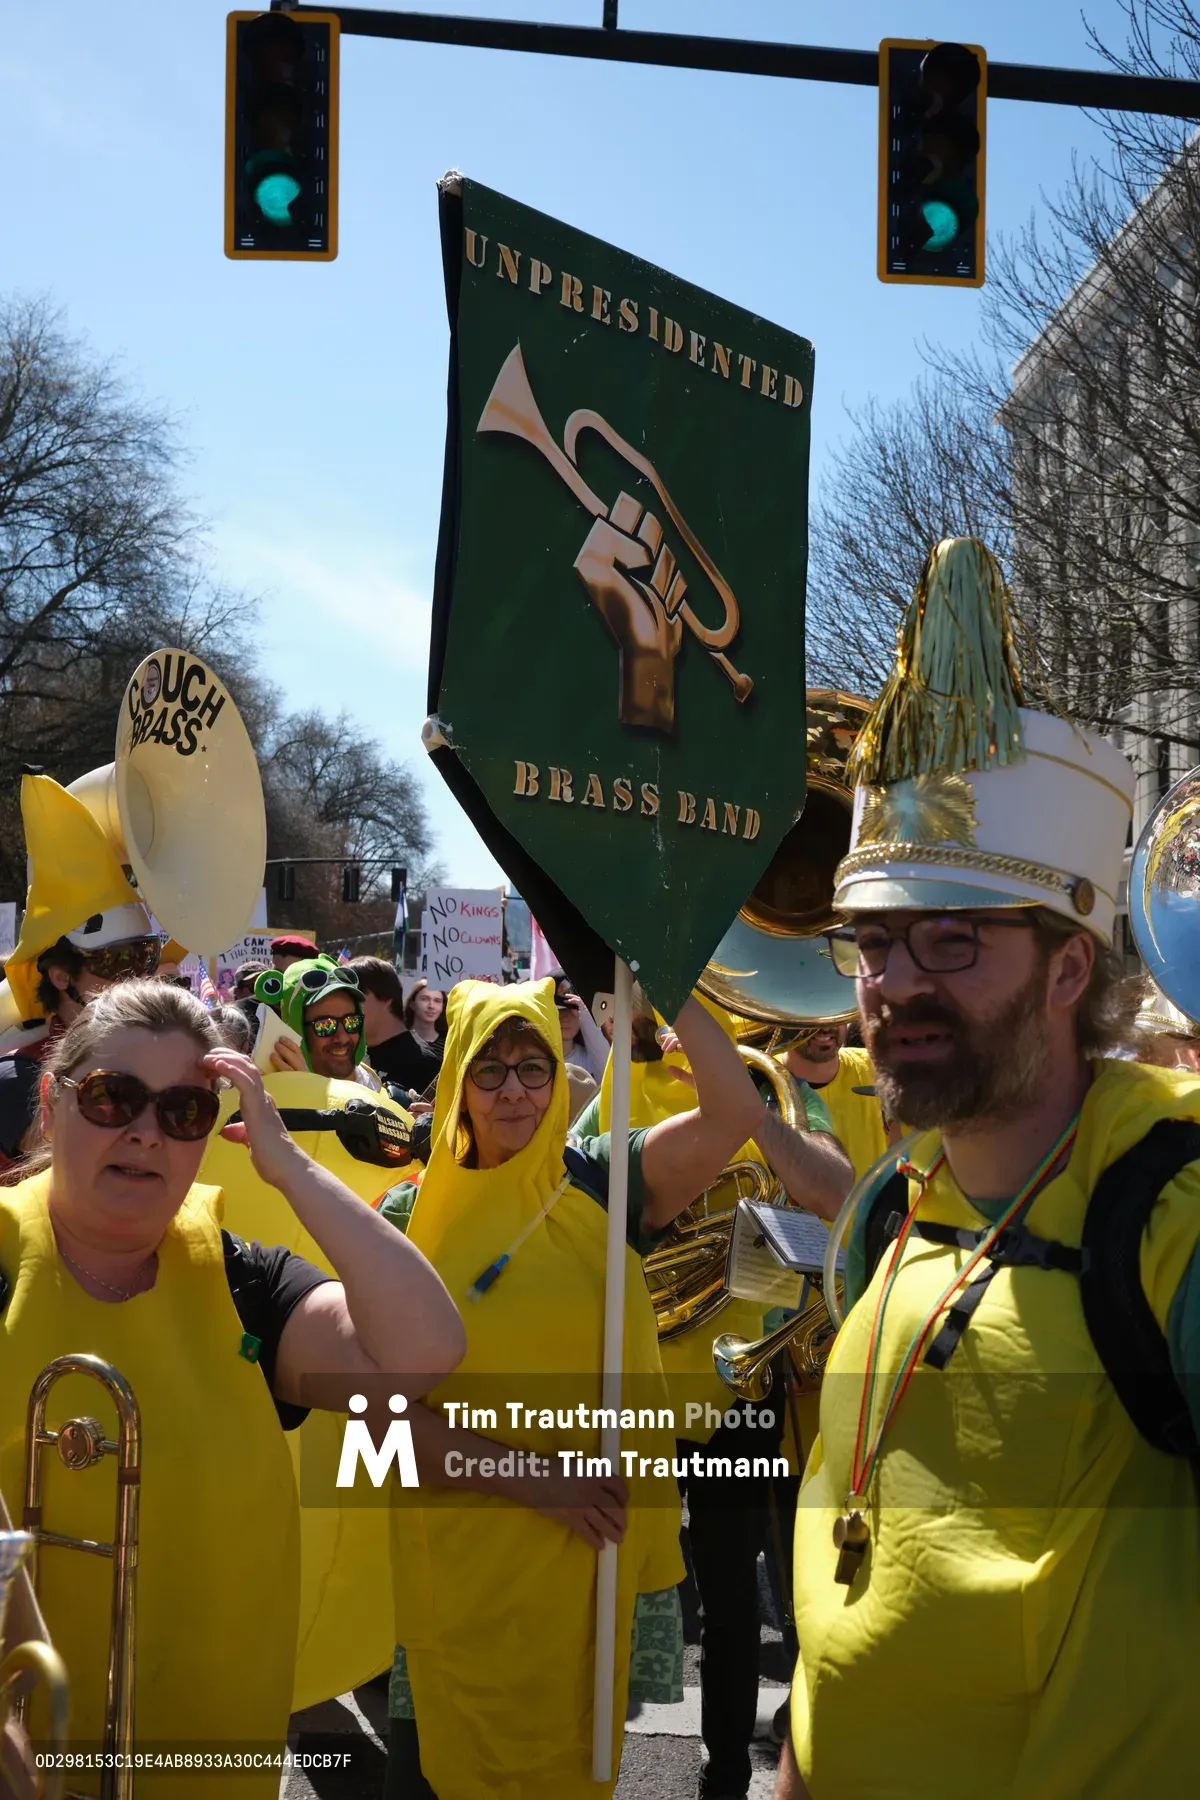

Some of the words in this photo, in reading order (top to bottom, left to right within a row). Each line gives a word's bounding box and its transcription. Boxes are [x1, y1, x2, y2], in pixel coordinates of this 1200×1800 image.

[464, 226, 804, 408] UNPRESIDENTED
[128, 654, 226, 730] COUCH
[129, 706, 203, 756] BRASS
[513, 760, 660, 815] BRASS
[677, 790, 761, 840] BAND
[430, 897, 457, 925] NO
[460, 901, 499, 917] KINGS
[433, 926, 460, 953] NO
[434, 955, 463, 981] NO
